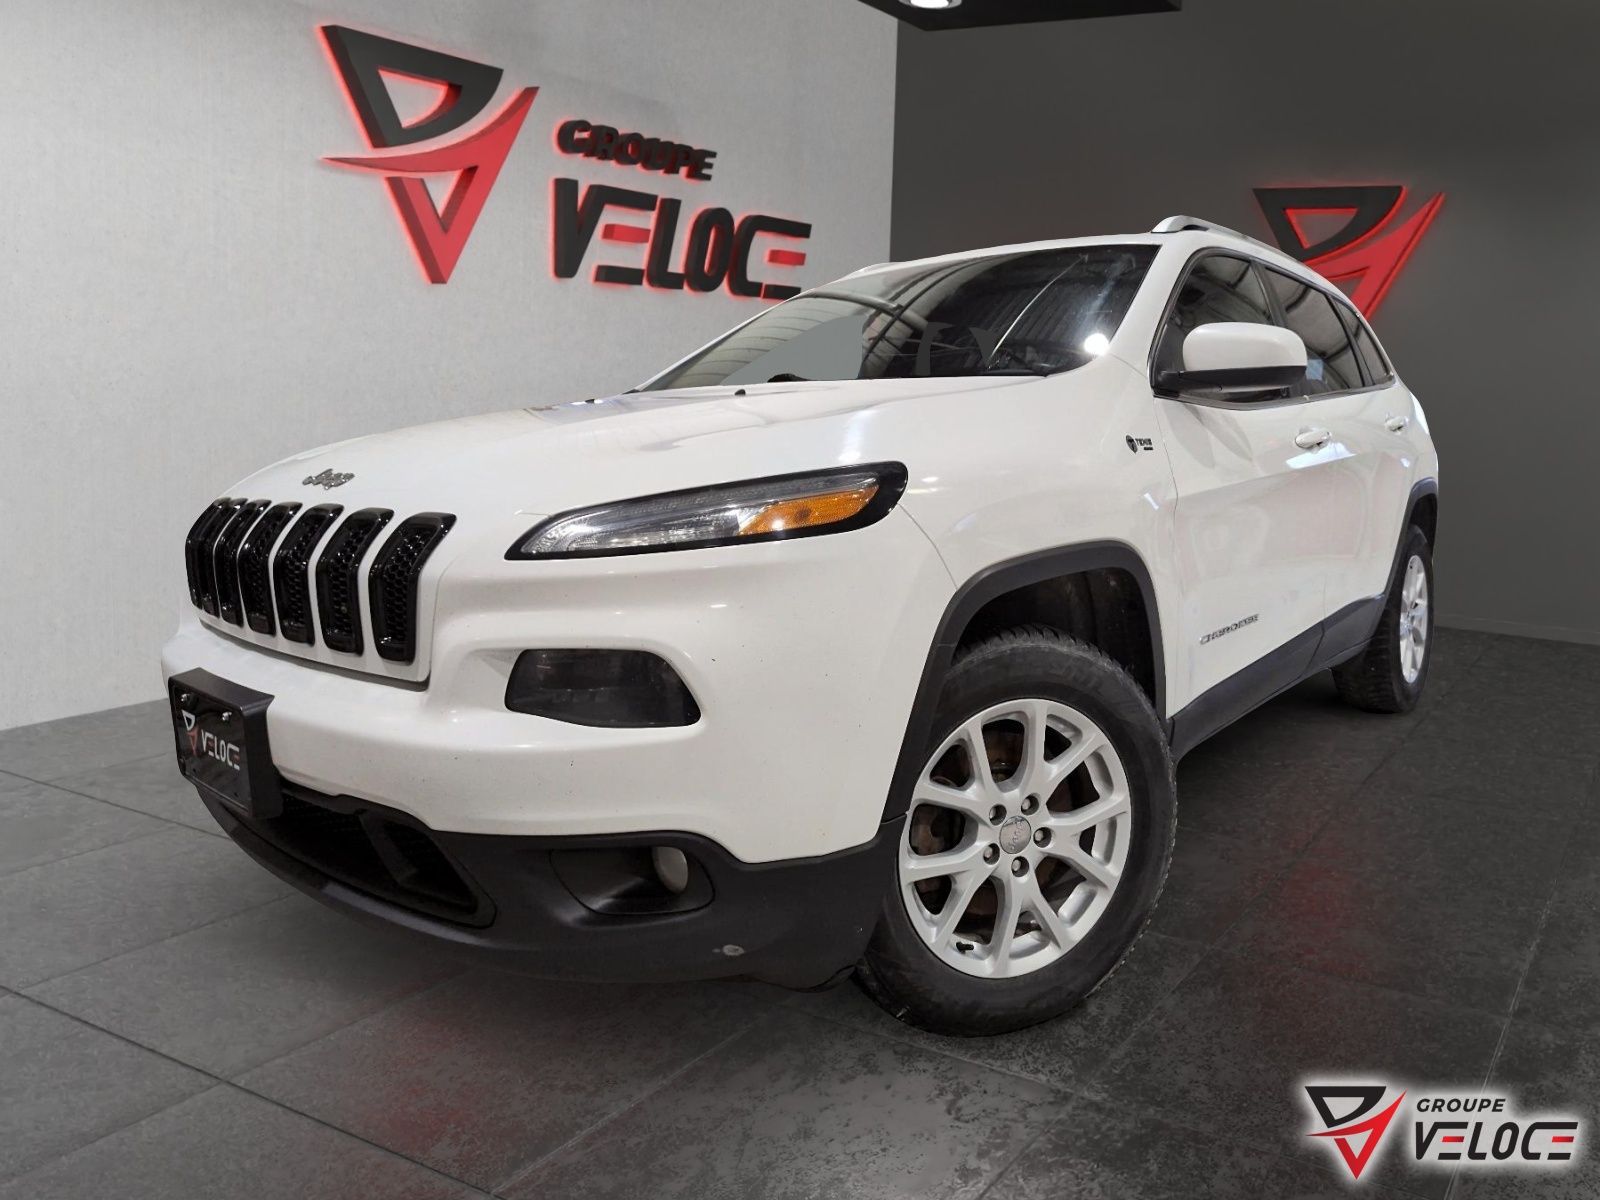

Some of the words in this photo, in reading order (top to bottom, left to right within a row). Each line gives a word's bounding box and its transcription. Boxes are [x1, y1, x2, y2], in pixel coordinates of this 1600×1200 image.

[556, 119, 718, 182] GROUPE
[551, 176, 813, 301] VELOCE
[200, 727, 242, 772] VELOCE
